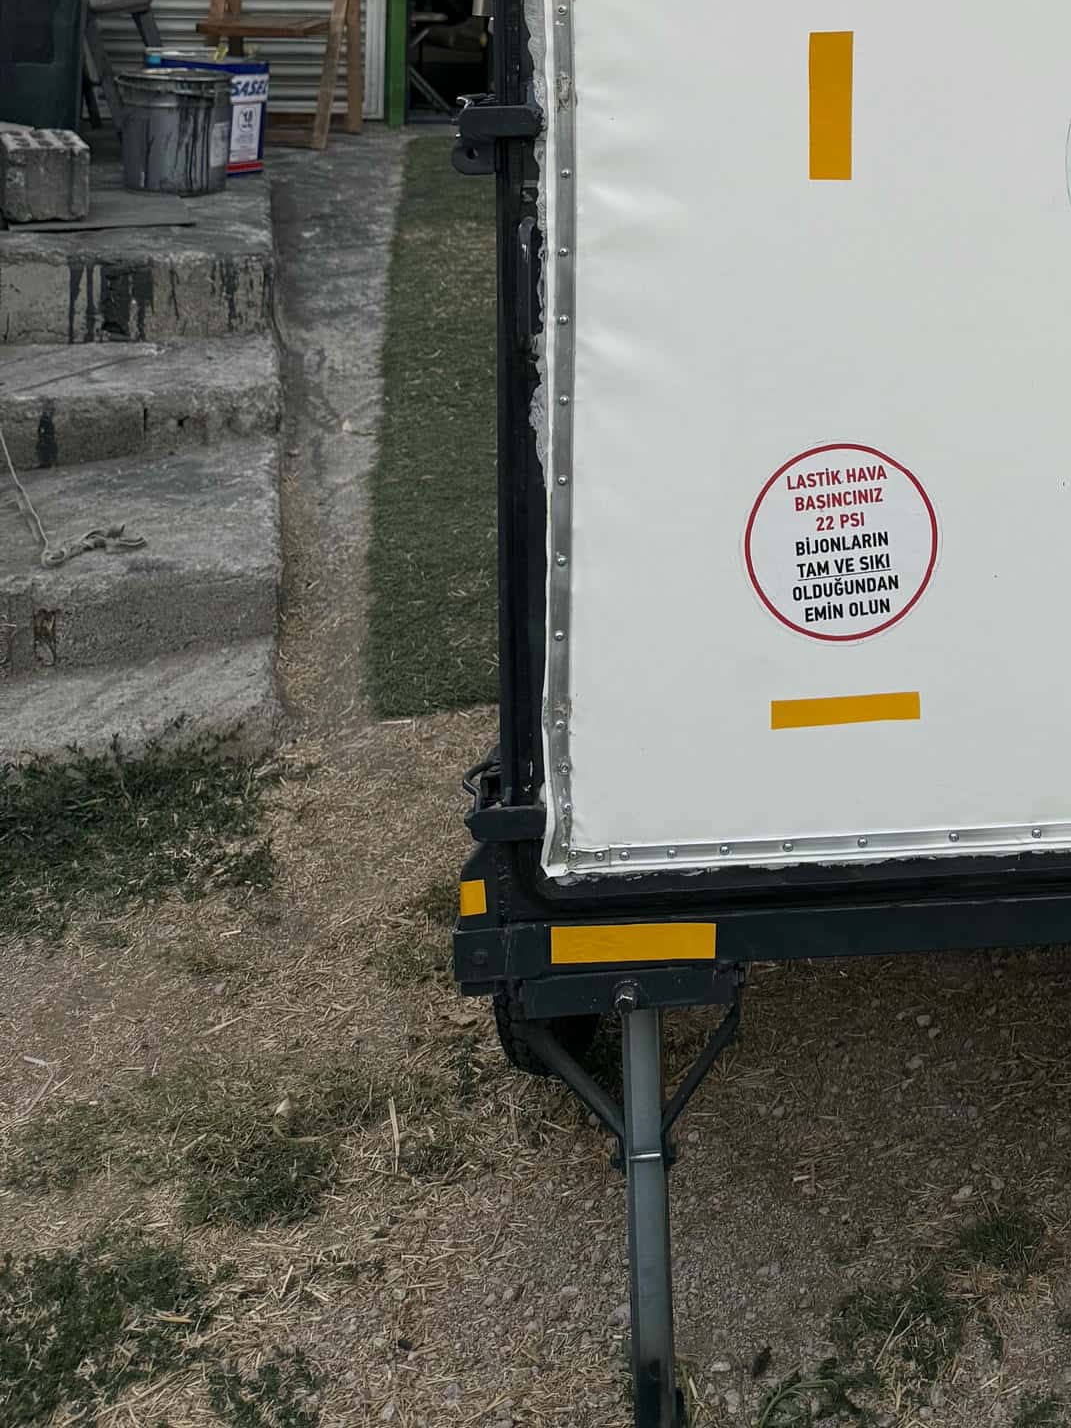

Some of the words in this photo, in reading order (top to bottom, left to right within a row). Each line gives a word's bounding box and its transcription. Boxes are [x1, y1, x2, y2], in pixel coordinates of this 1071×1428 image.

[787, 468, 841, 490] LASTİK
[846, 465, 887, 483] HAVA
[816, 516, 834, 531] 22
[840, 512, 864, 528] PSI
[796, 531, 888, 556] BİJONLARIN
[797, 561, 829, 578] TAM
[835, 558, 854, 573] VE
[860, 554, 891, 571] SIKI
[793, 575, 898, 601] OLDUĞUNDAN
[805, 602, 843, 622] EMİN
[849, 599, 890, 617] OLUN
